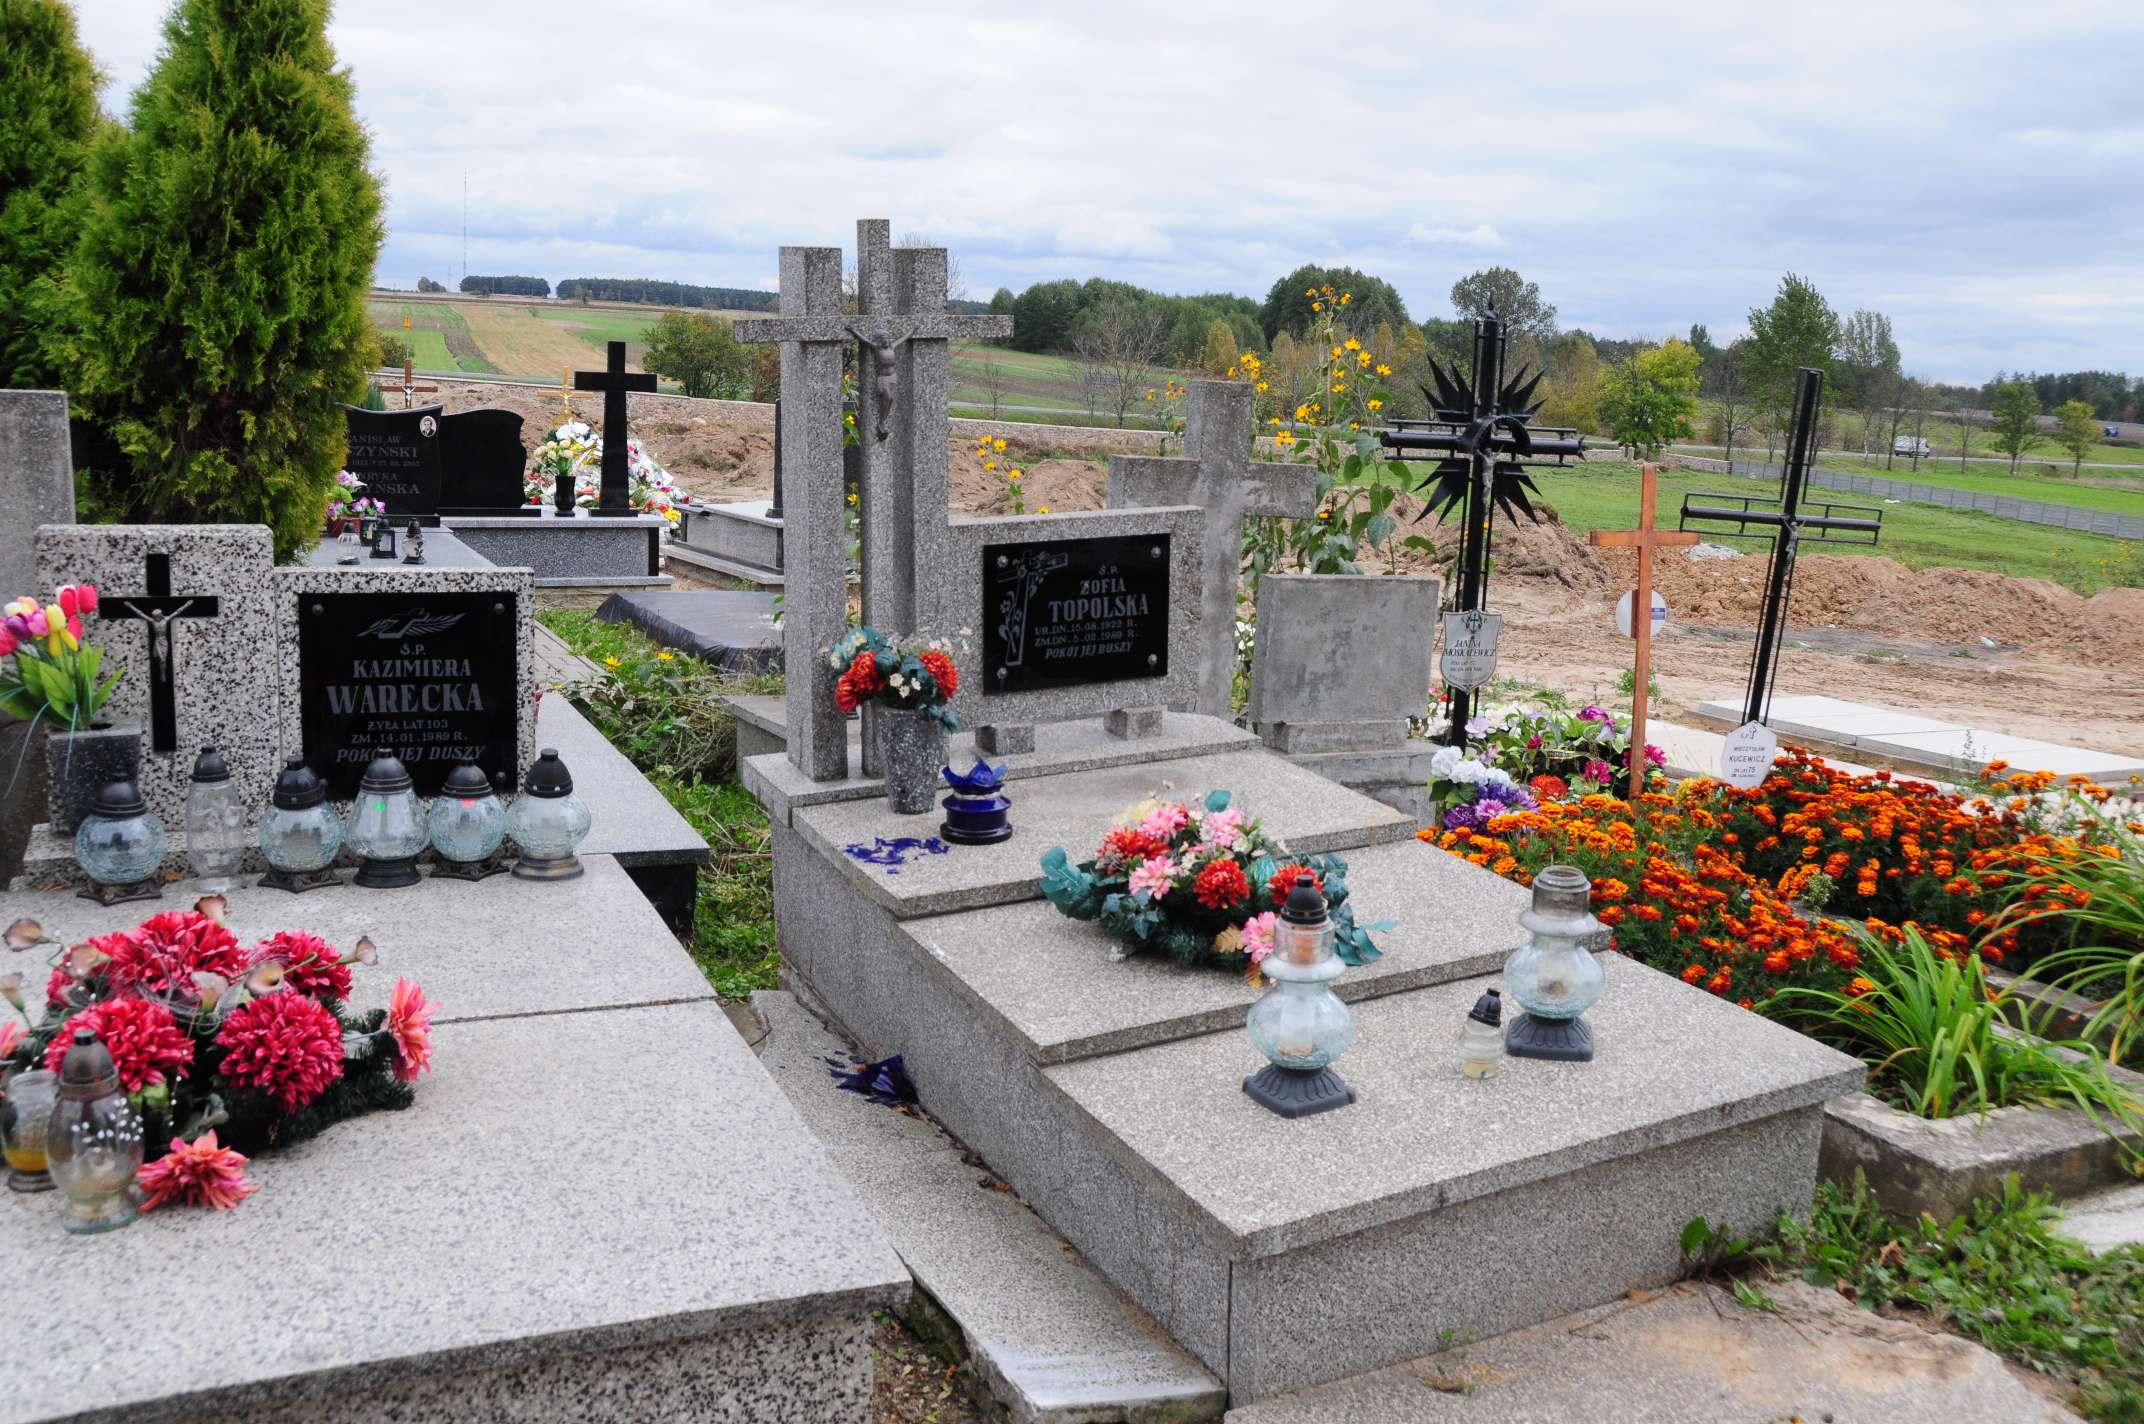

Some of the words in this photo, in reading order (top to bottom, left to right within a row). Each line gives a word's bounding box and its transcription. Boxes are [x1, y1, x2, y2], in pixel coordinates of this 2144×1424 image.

[1079, 577, 1126, 595] ZOFIA
[1048, 593, 1149, 622] TOPOLSKA
[353, 658, 472, 679] KAZIMIERA
[326, 683, 484, 715] WARECKA
[402, 720, 425, 729] LAT
[427, 719, 449, 729] 103
[428, 746, 486, 760] DUSZY
